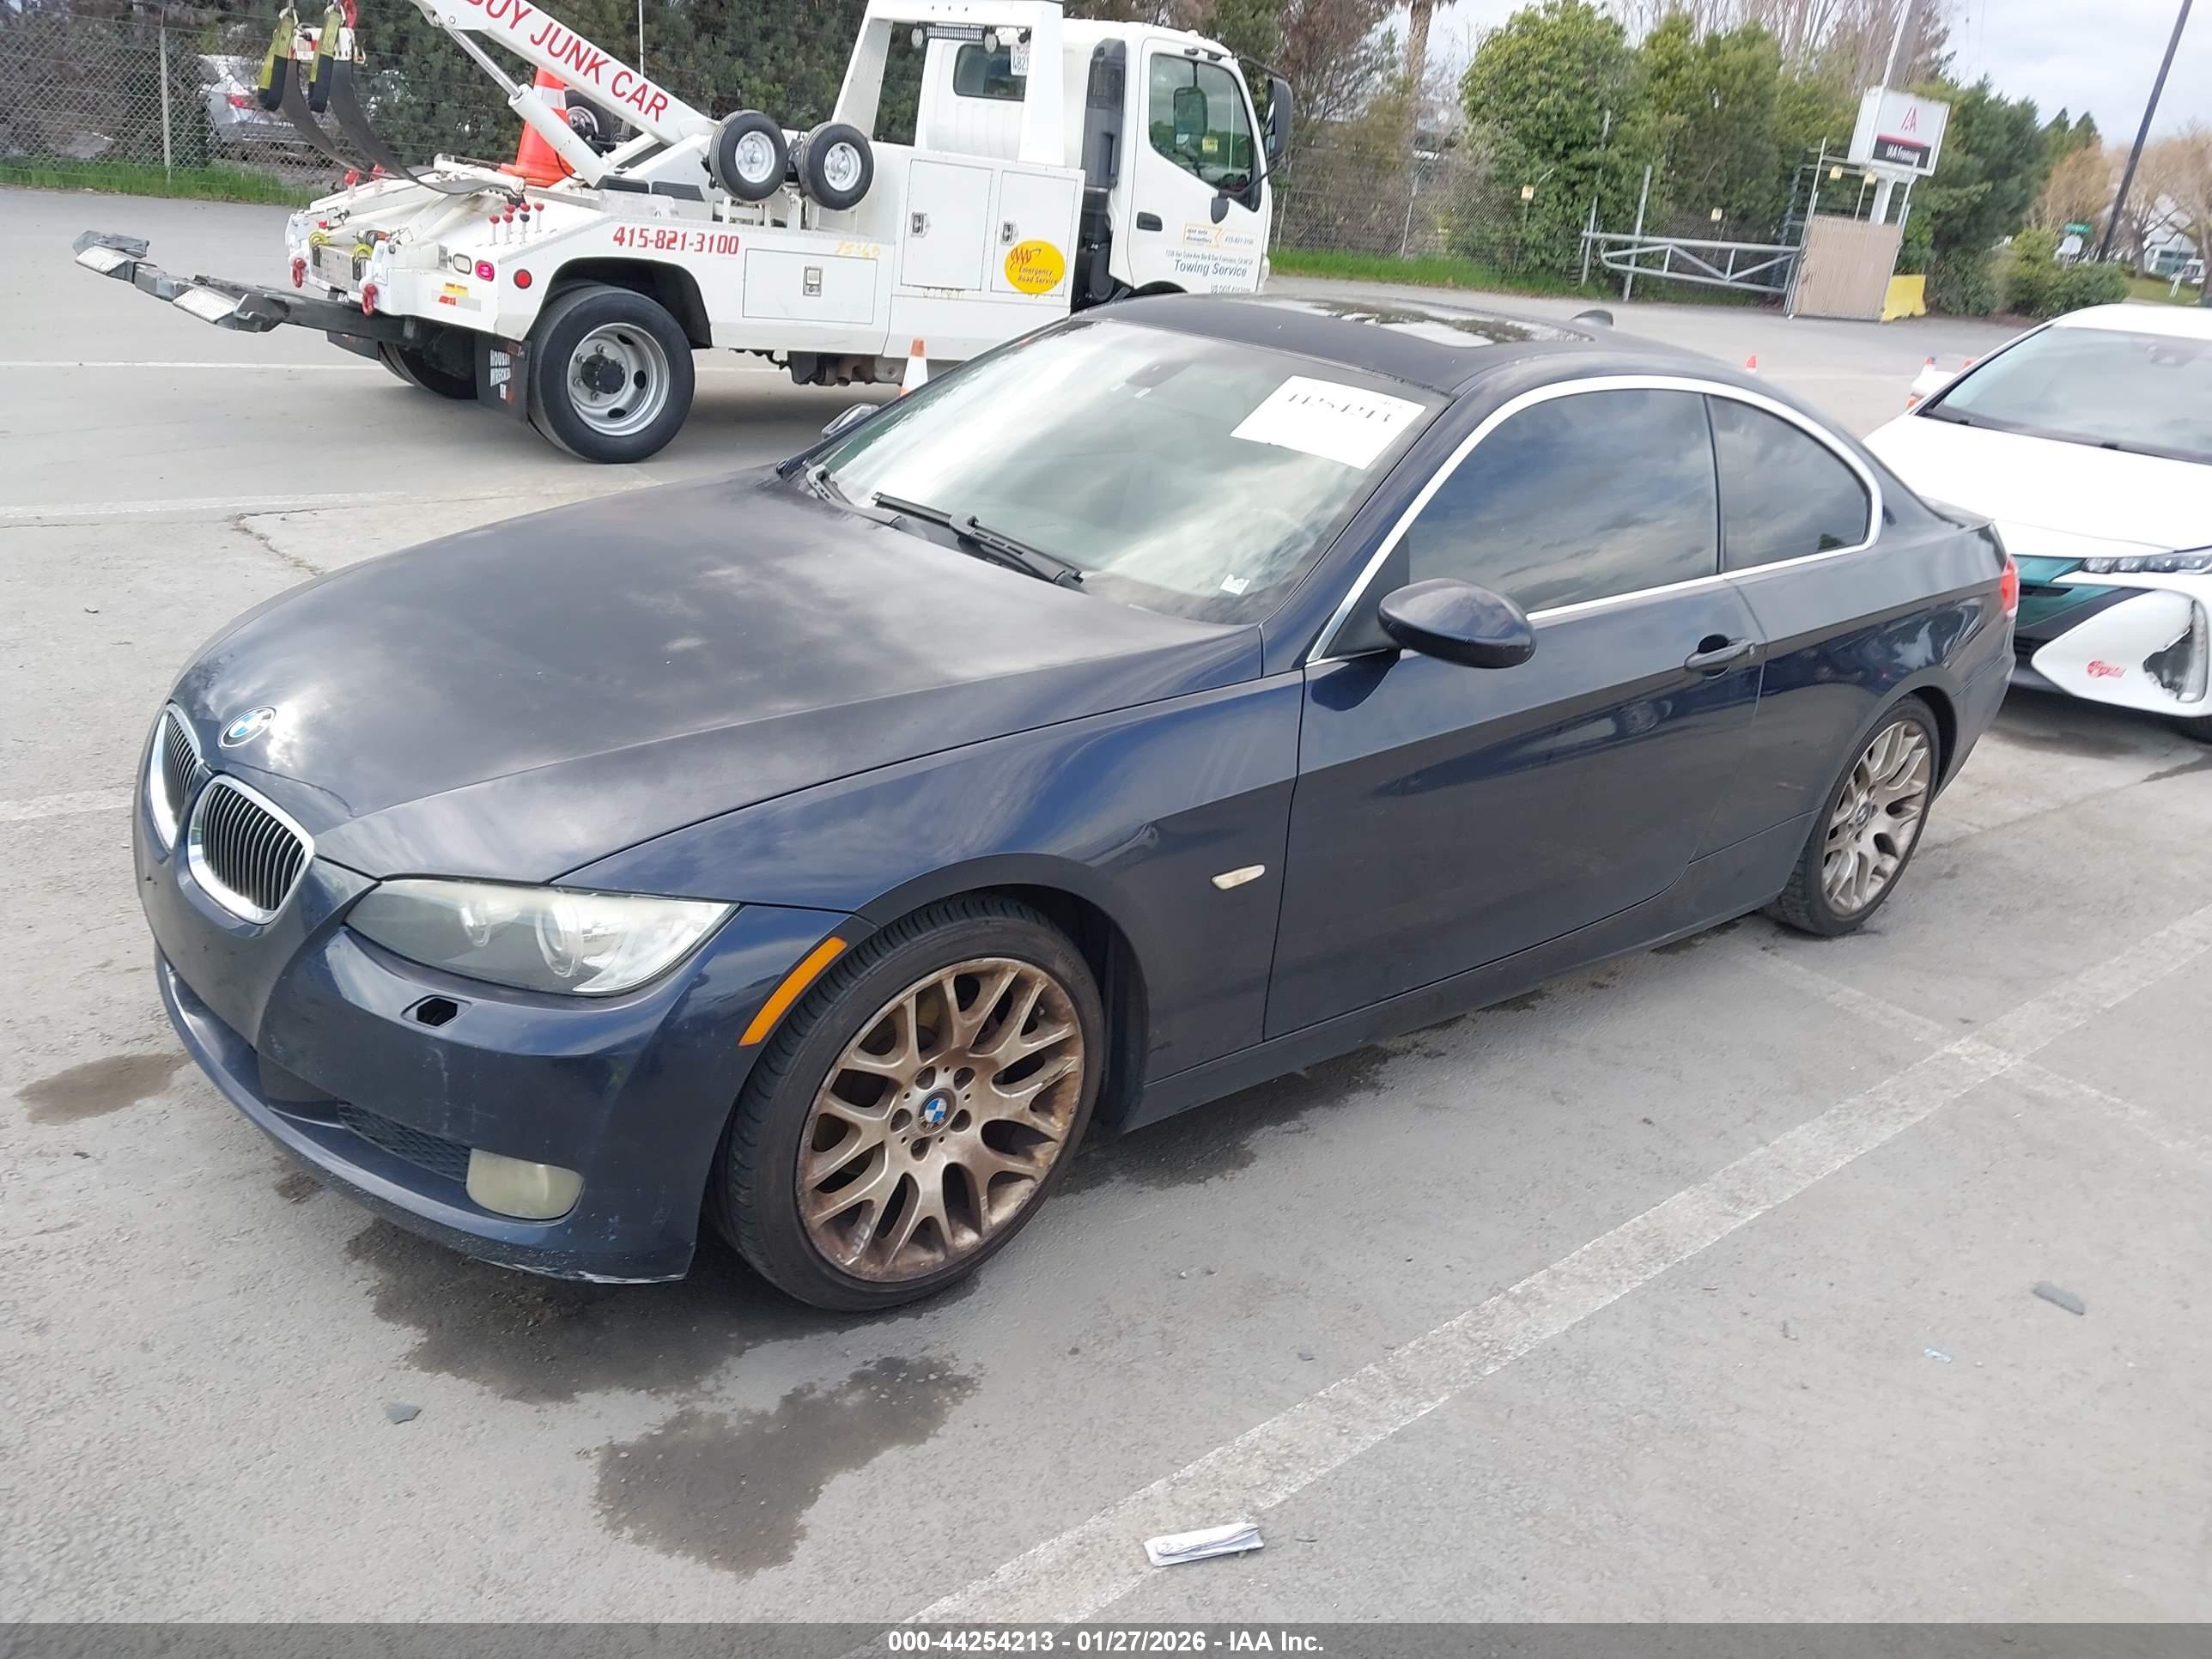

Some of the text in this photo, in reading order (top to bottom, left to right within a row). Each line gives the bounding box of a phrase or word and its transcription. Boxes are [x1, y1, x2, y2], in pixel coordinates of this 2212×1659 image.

[466, 0, 669, 123] UY JUNK CAR
[612, 226, 739, 255] 415-821-3100
[1018, 265, 1053, 277] Emergency
[1174, 259, 1211, 276] Towing
[1017, 275, 1059, 287] Road Service
